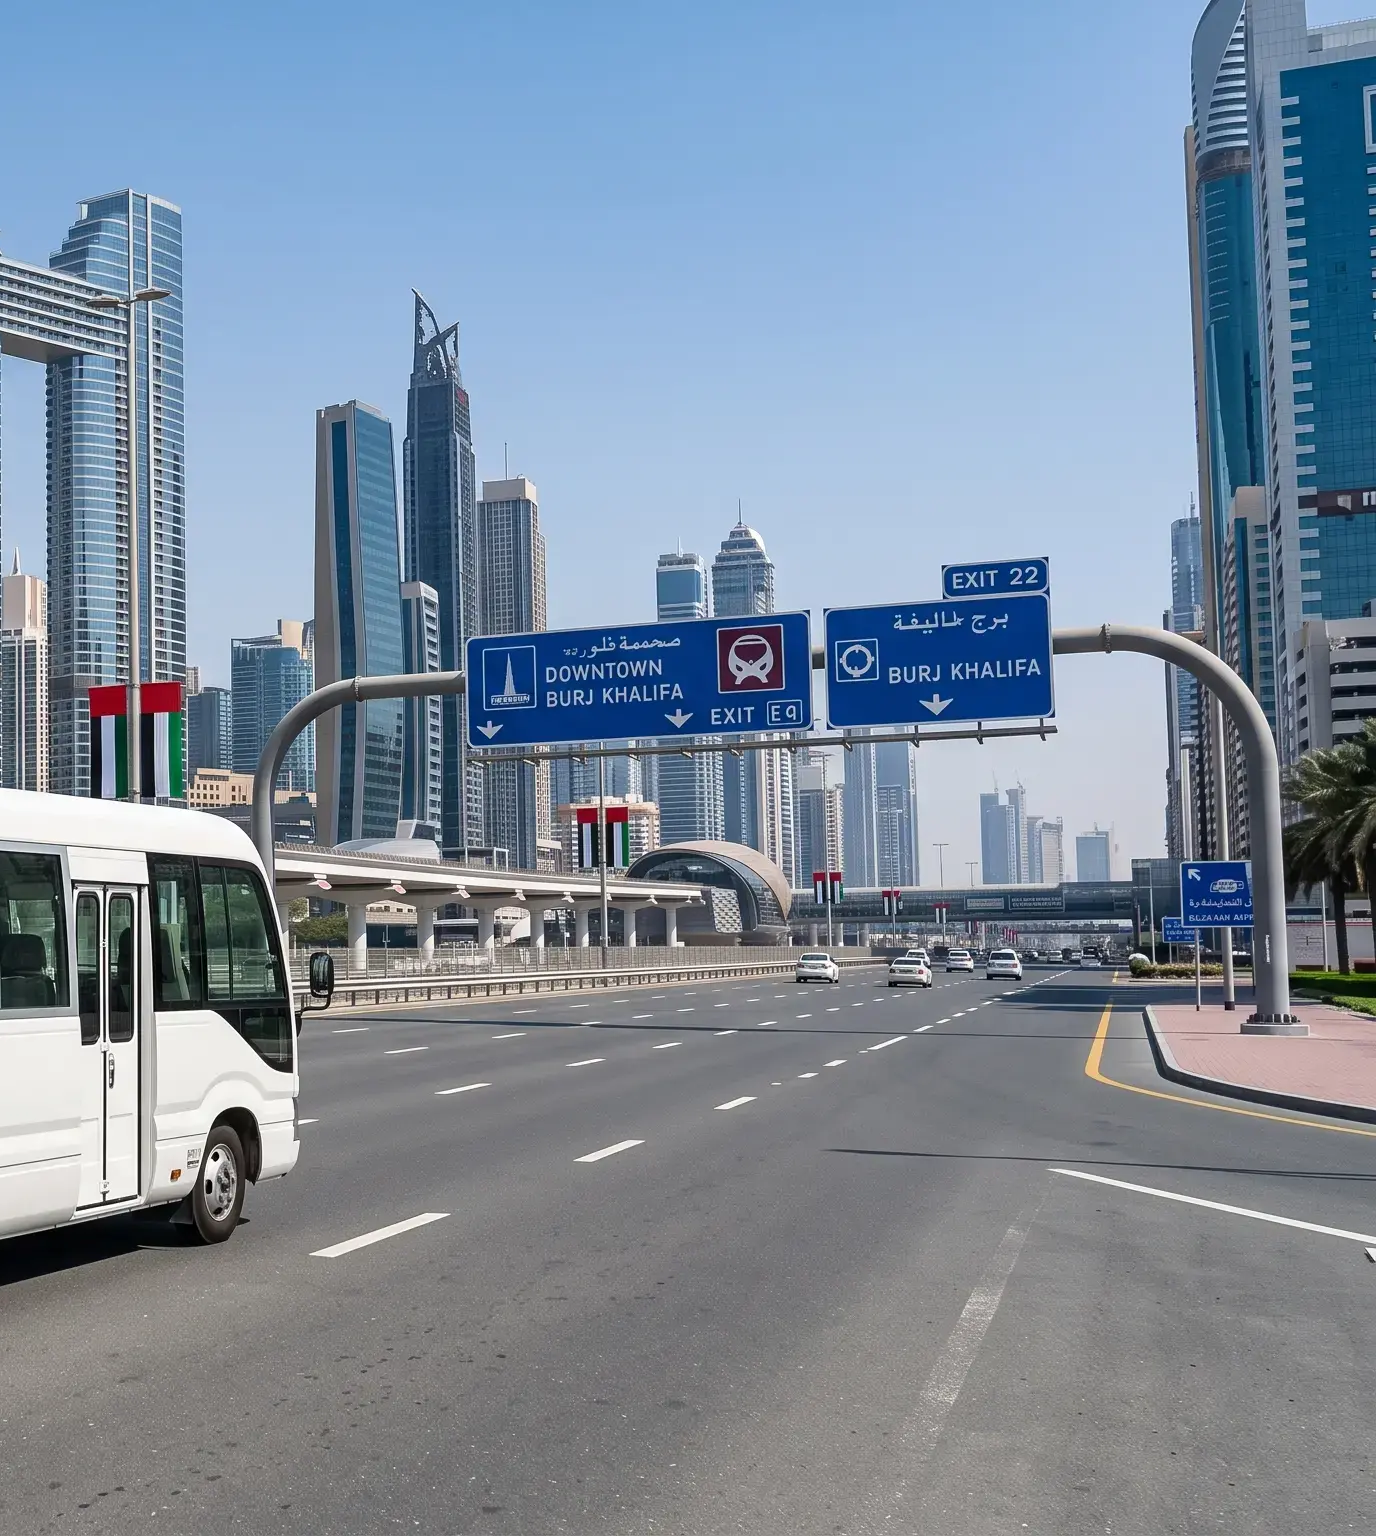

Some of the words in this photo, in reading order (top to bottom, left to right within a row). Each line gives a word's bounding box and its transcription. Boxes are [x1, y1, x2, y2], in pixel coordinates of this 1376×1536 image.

[952, 569, 999, 589] EXIT
[1009, 566, 1039, 586] 22
[971, 612, 1009, 634] برج
[545, 658, 663, 683] DOWNTOWN
[888, 664, 941, 684] BURJ
[950, 658, 1042, 681] KHALIFA
[546, 689, 594, 708] BURJ
[602, 683, 684, 704] KHALIFA
[711, 706, 755, 725] EXIT
